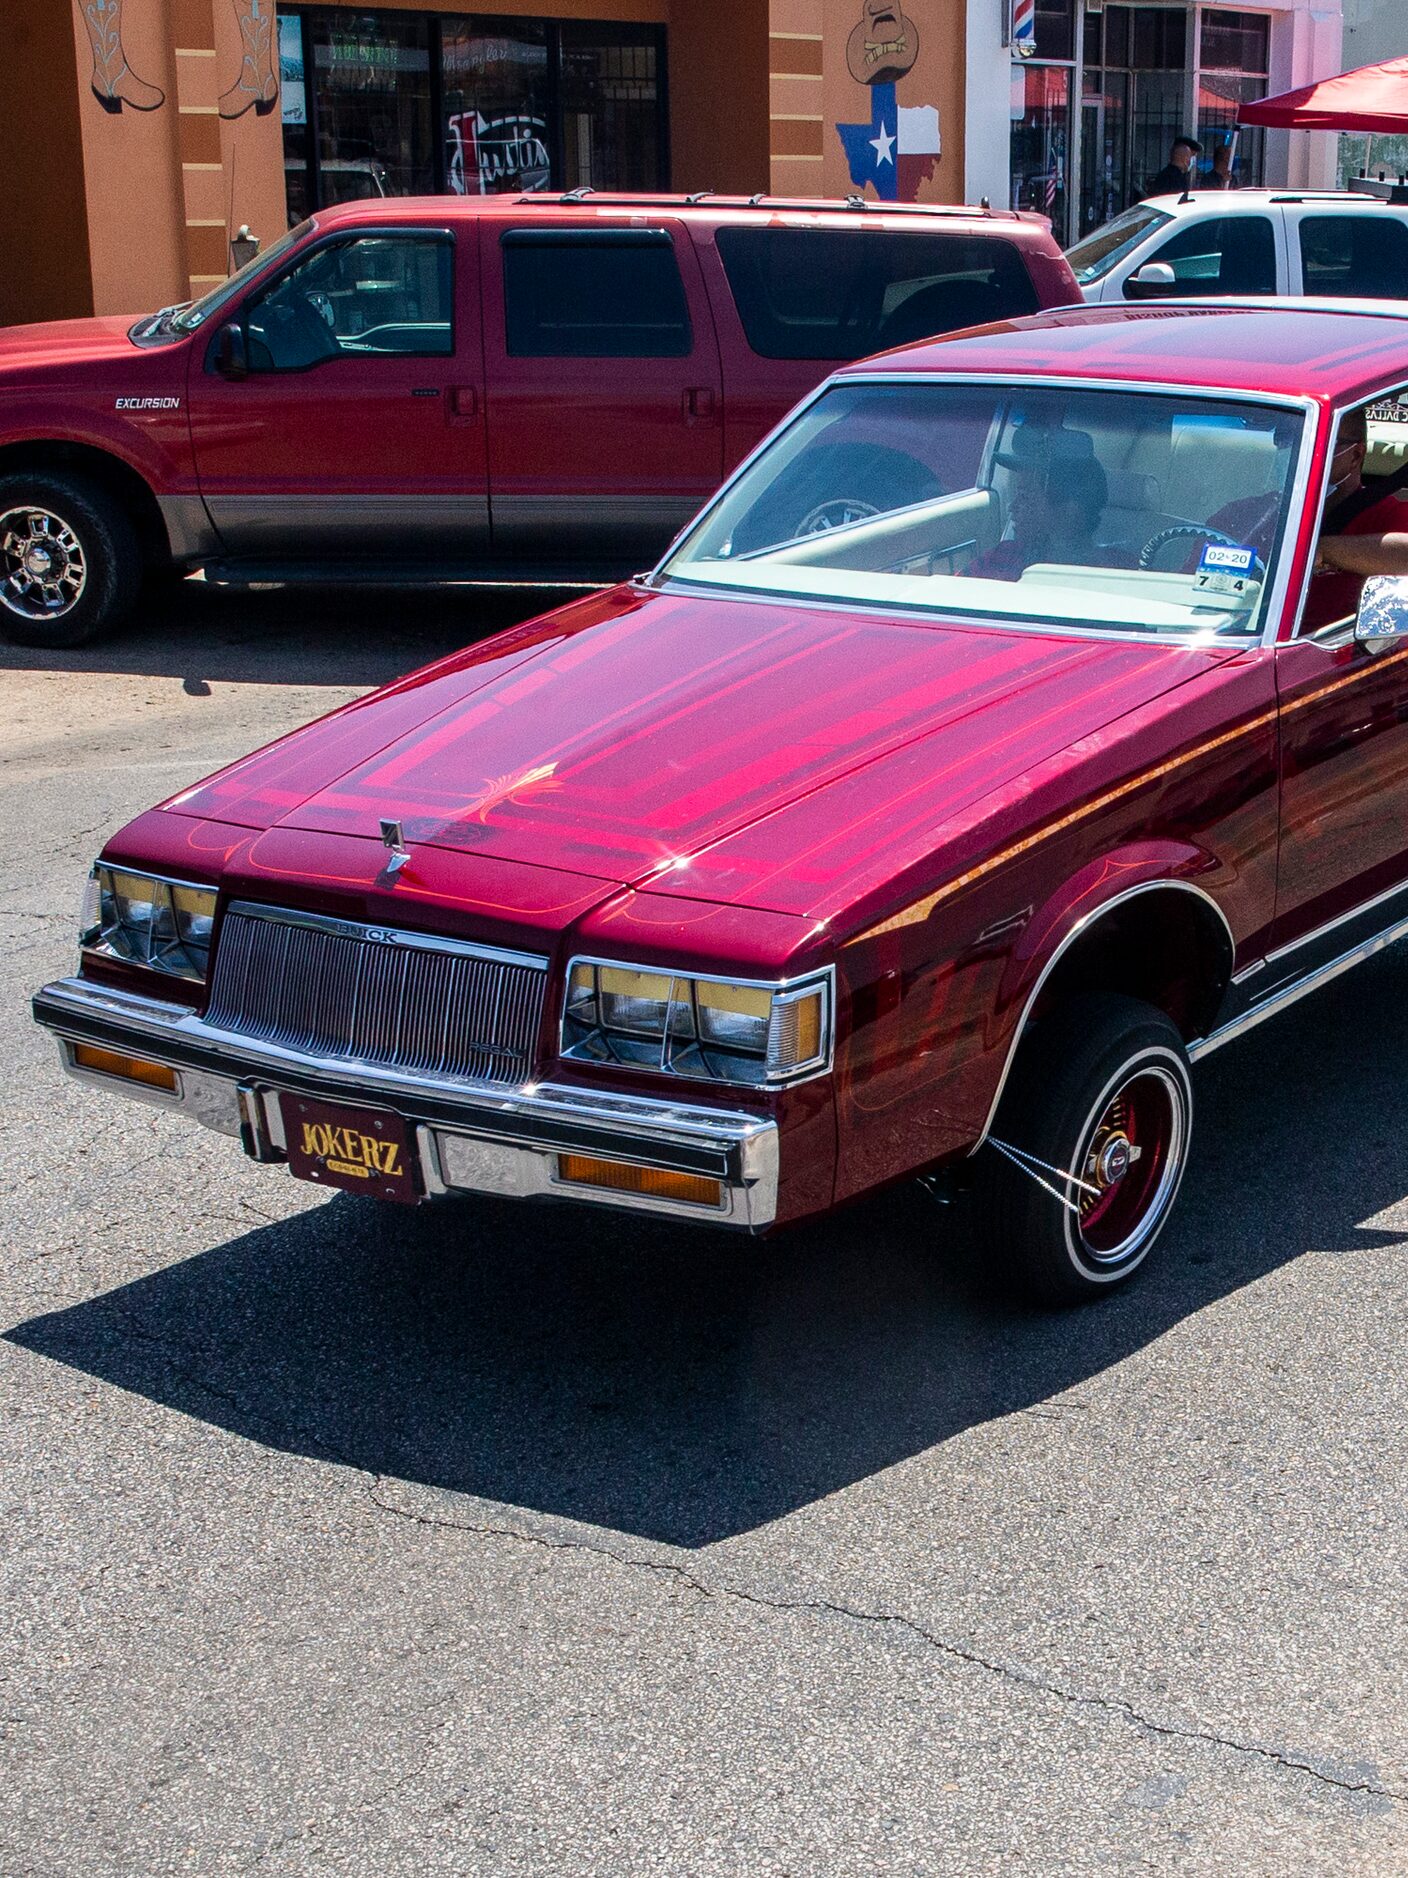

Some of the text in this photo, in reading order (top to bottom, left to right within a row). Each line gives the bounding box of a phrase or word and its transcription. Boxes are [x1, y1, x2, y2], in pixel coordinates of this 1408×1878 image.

[115, 397, 181, 410] EXCURSION
[1199, 575, 1210, 586] 7
[1233, 580, 1244, 591] 4
[335, 924, 398, 943] BUICK
[469, 1041, 524, 1059] REGAL
[300, 1122, 404, 1177] JOKERZ
